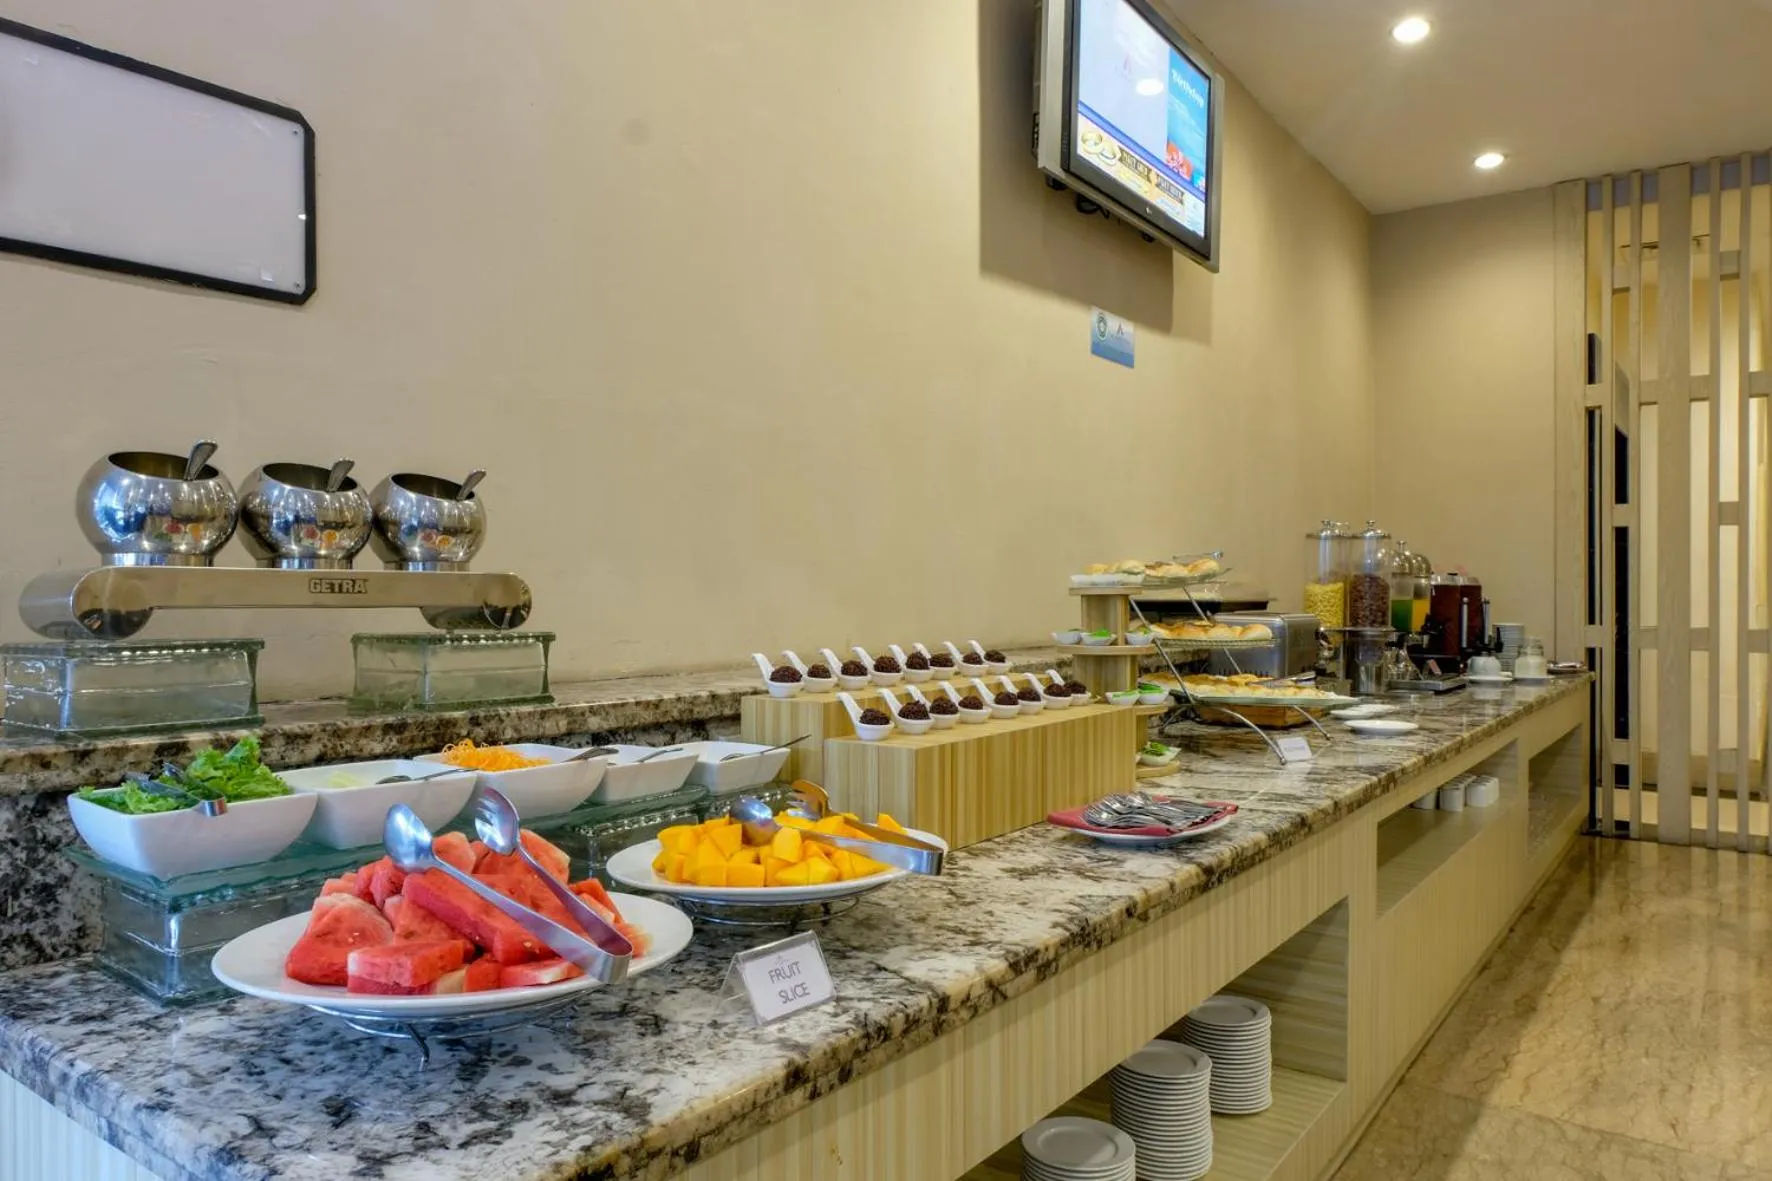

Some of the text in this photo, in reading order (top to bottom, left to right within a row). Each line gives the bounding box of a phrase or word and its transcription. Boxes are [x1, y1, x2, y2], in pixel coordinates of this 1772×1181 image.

[310, 579, 367, 594] GETRA
[768, 961, 802, 985] FRUIT
[778, 982, 810, 1004] SLICE
